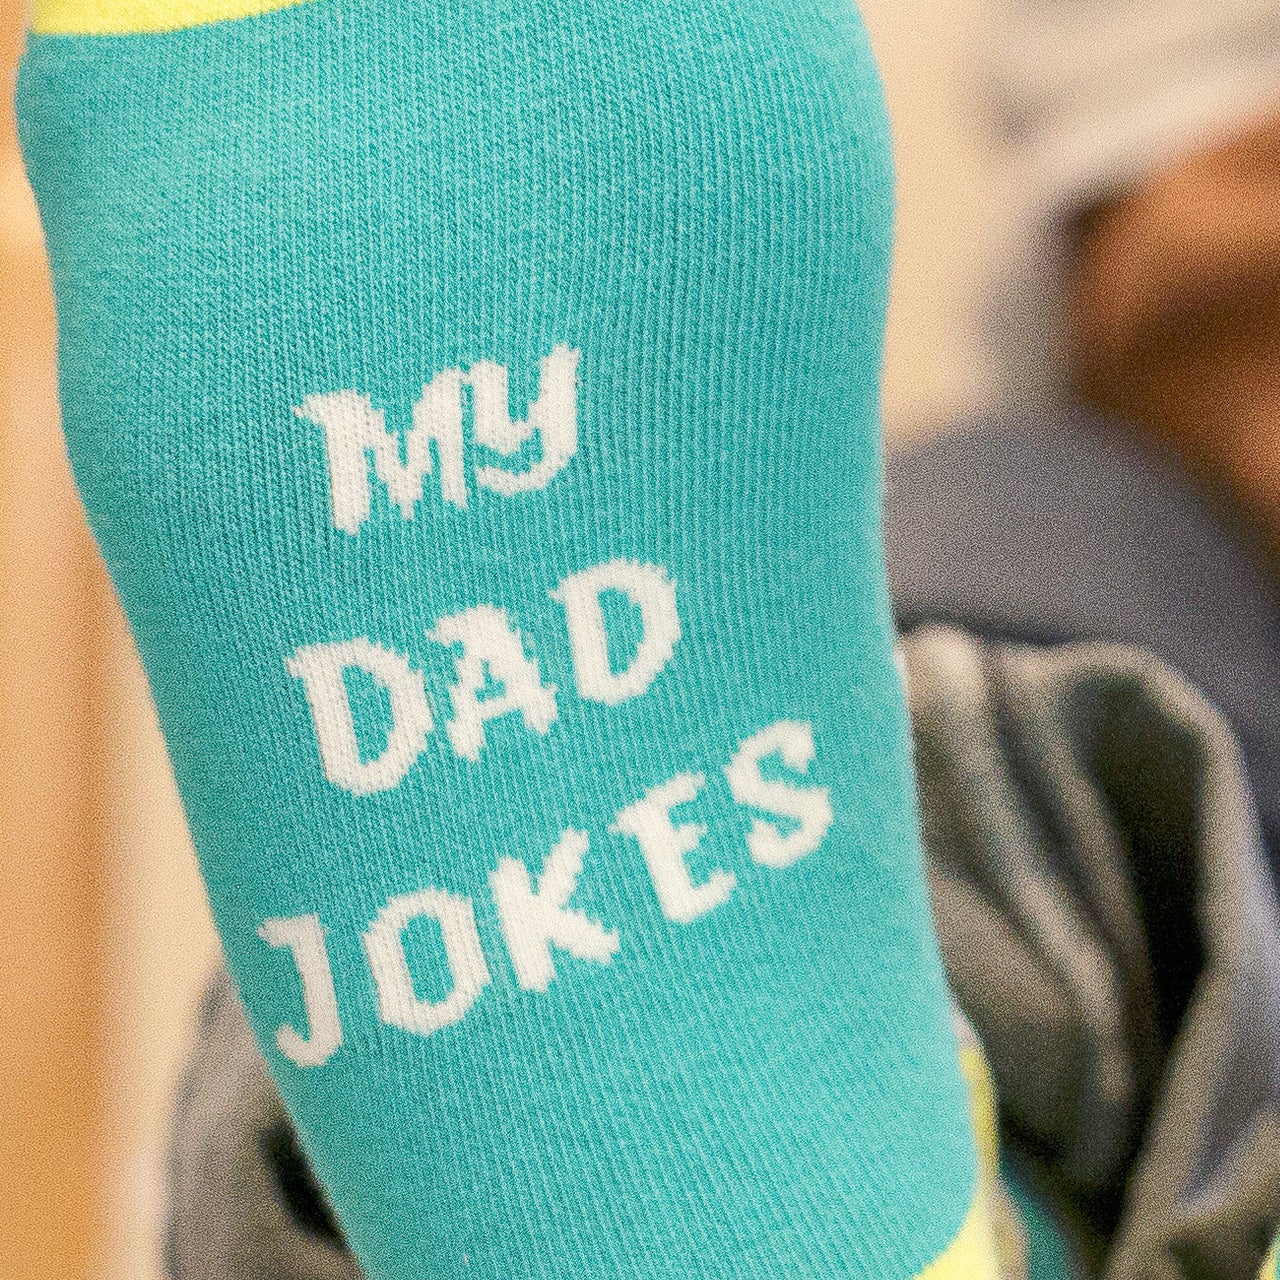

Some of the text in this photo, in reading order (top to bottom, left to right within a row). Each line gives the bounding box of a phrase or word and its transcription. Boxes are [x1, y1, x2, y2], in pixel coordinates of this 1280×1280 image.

[291, 340, 583, 536] MY
[285, 557, 682, 797] DAD
[257, 719, 834, 1067] JOKES
